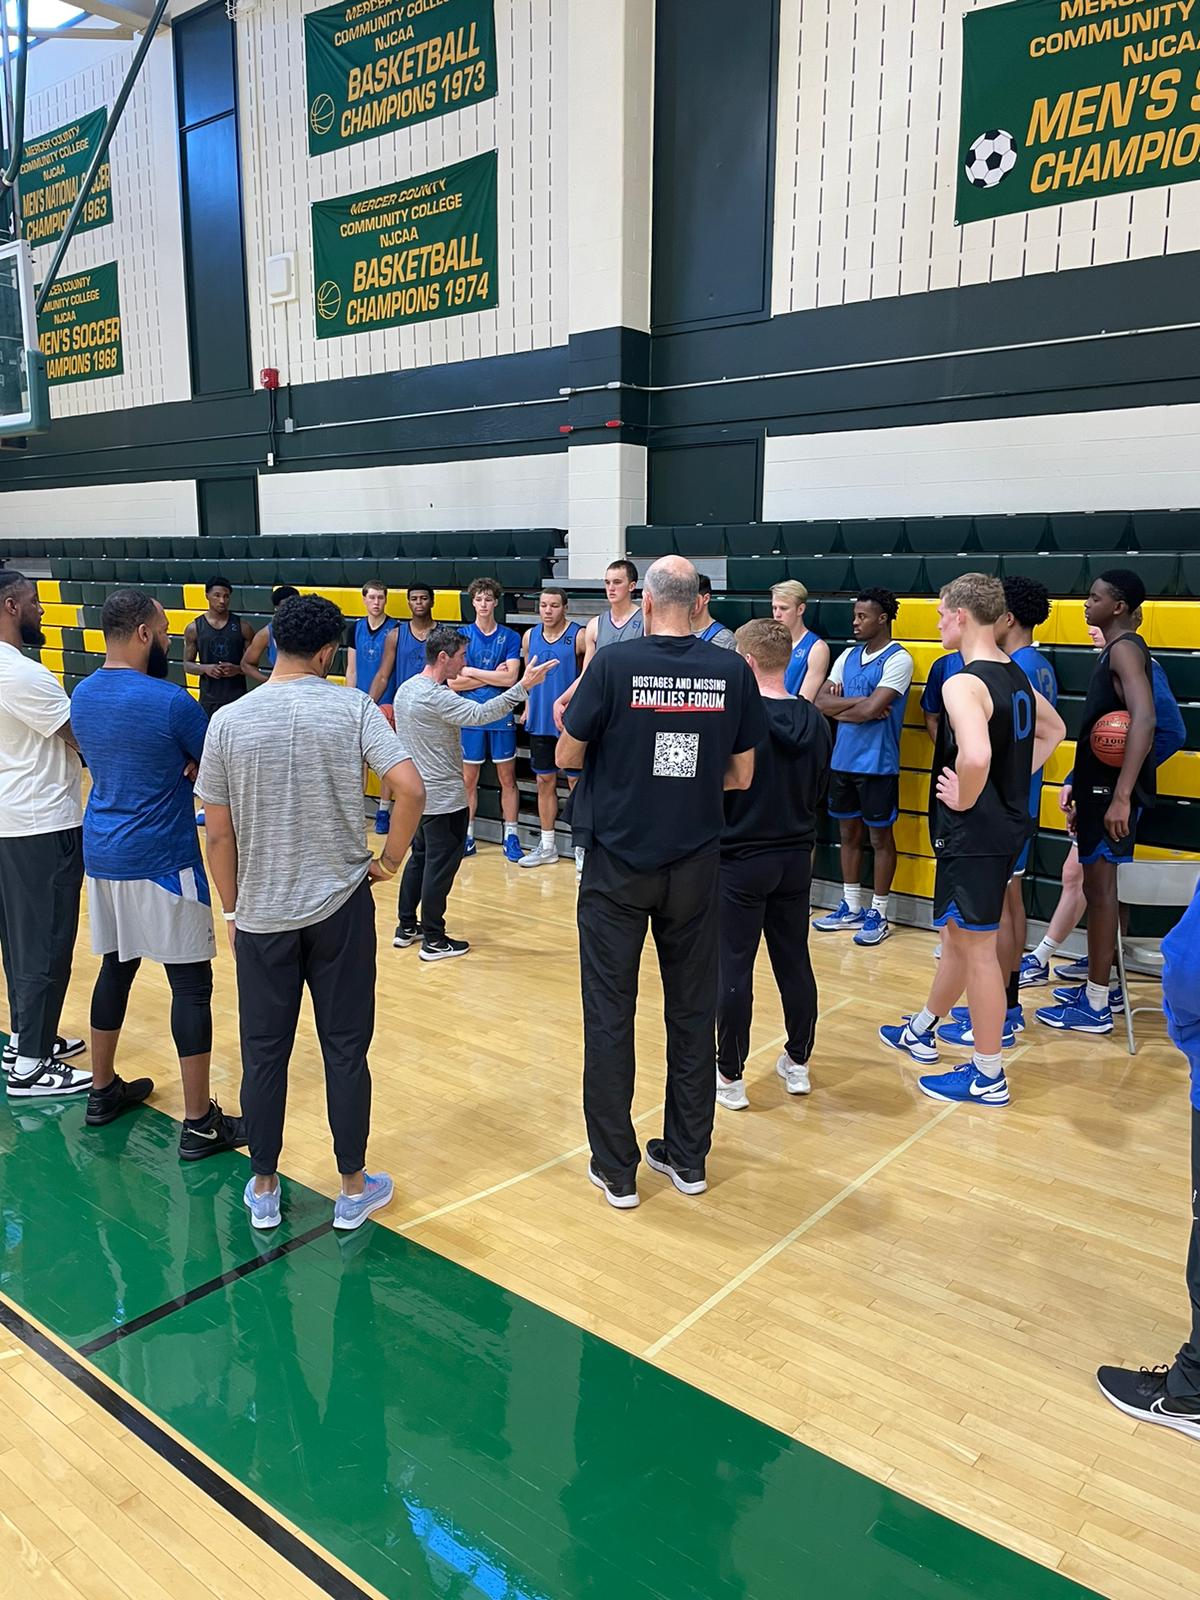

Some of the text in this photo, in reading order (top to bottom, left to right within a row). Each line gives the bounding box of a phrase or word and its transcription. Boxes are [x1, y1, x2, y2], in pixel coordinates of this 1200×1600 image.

[334, 7, 404, 46] COMMUNITY
[375, 25, 414, 52] NJCAA
[1029, 0, 1196, 58] COMMUNITY
[347, 22, 480, 102] BASKETBALL
[1122, 30, 1200, 67] NJCA
[341, 60, 486, 138] CHAMPIONS 1973
[1025, 68, 1182, 147] MEN'S
[20, 137, 89, 175] COMMUNITY COLLEGE
[25, 125, 80, 158] MERCER COUNTY
[42, 163, 66, 181] NJCAA
[45, 175, 79, 211] NATIONAL
[82, 195, 107, 223] 1963
[350, 177, 447, 215] MERCER COUNTY
[339, 193, 463, 238] COMMUNITY COLLEGE
[379, 226, 419, 248] NJCAA
[352, 232, 484, 294] BASKETBALL
[63, 275, 91, 293] COUNTY
[70, 289, 100, 306] COLLEGE
[346, 271, 490, 326] CHAMPIONS 1974
[53, 310, 77, 325] NJCAA
[72, 317, 120, 350] SOCCER
[93, 347, 118, 371] 1968
[632, 675, 727, 692] HOSTAGES AND MISSING
[632, 689, 726, 709] FAMILIES FORUM
